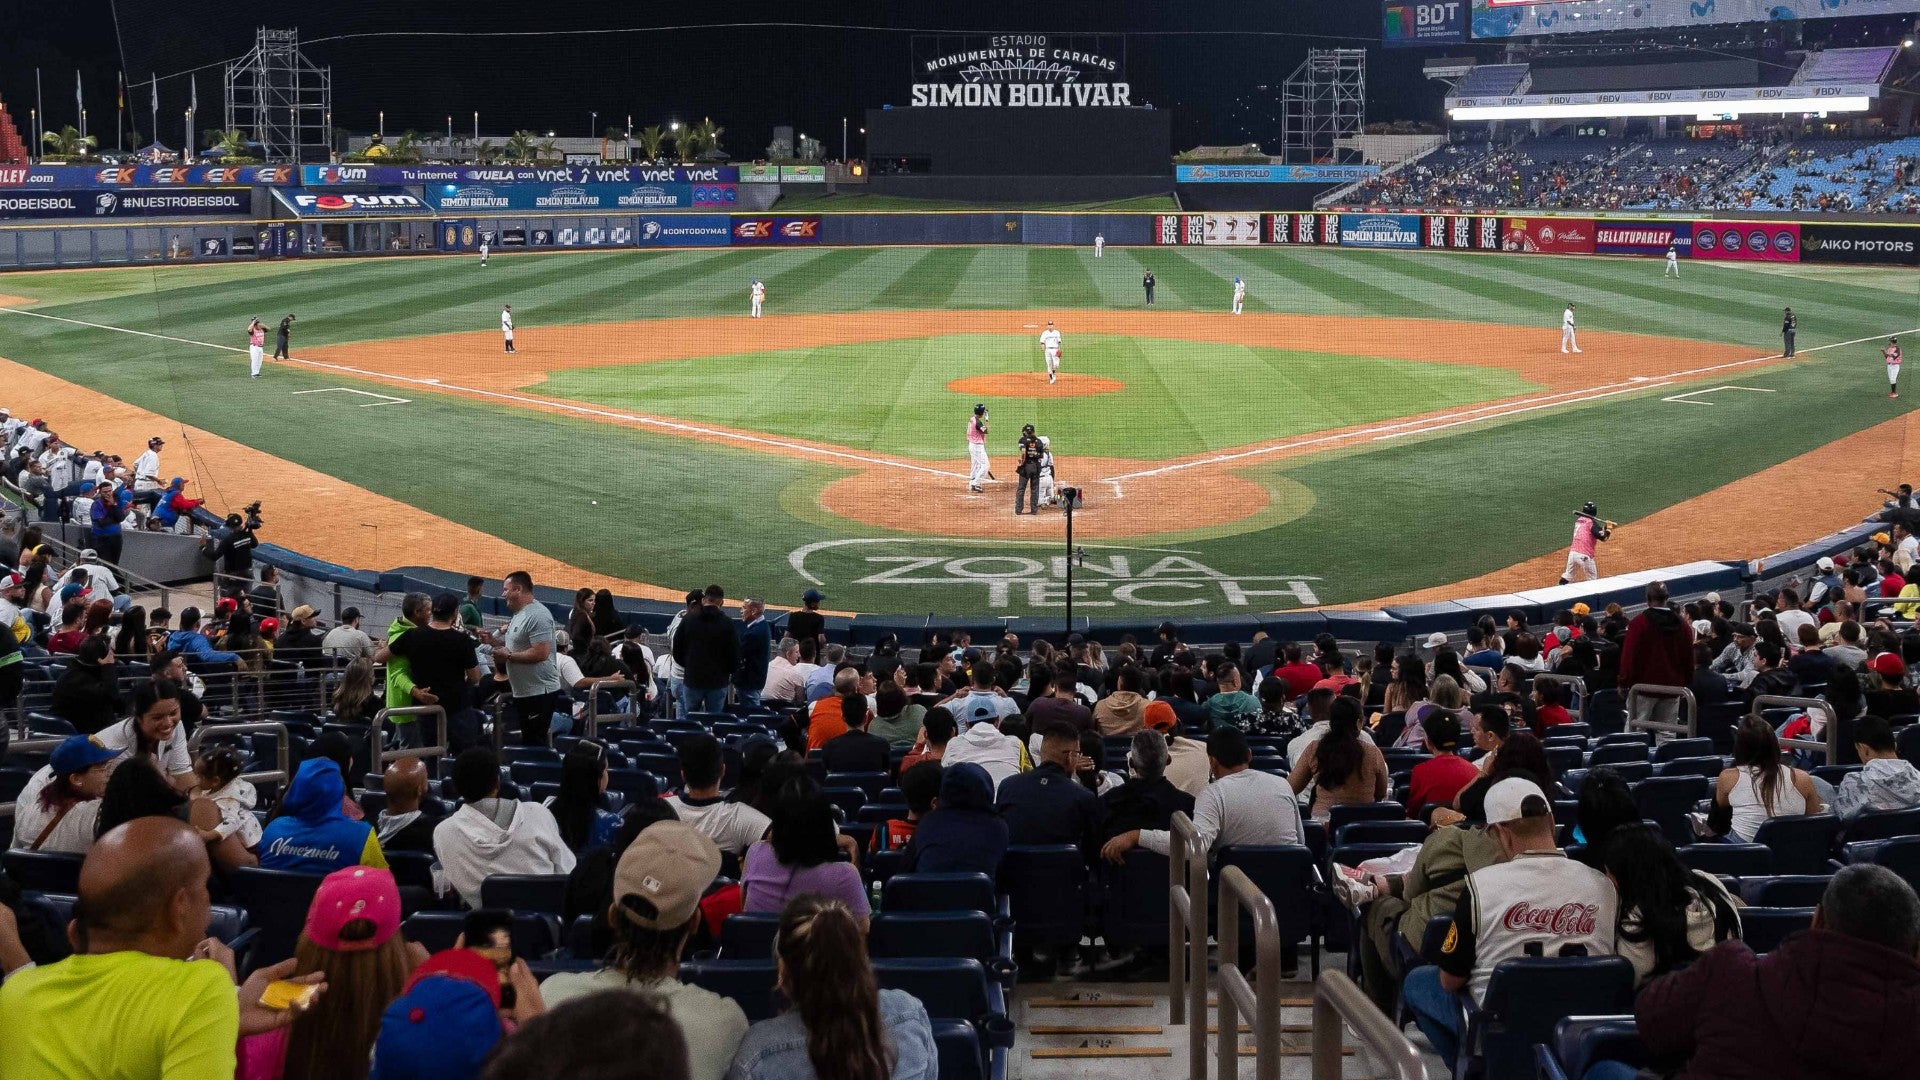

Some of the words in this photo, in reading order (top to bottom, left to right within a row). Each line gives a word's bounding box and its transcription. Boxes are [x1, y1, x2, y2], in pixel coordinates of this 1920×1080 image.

[1417, 2, 1459, 25] BDT
[992, 35, 1046, 47] ESTADIO
[926, 48, 1022, 72] MONUMENTAL
[1029, 48, 1045, 58] DE
[1053, 49, 1116, 71] CARACAS
[911, 76, 1002, 107] SIMÓN
[1008, 76, 1131, 107] BOLÍVAR
[1763, 89, 1782, 97] BDV
[1821, 87, 1841, 96] BDV
[401, 170, 416, 180] Tu
[418, 170, 458, 180] internet
[474, 170, 514, 181] VUELA
[1245, 170, 1271, 178] POLLO
[123, 197, 239, 208] #NUESTROBEISBOL
[1820, 240, 1850, 249] AIKO
[1855, 241, 1913, 251] MOTORS
[853, 556, 1226, 583] ZONA
[981, 578, 1321, 608] TECH
[270, 837, 340, 861] Venezuela
